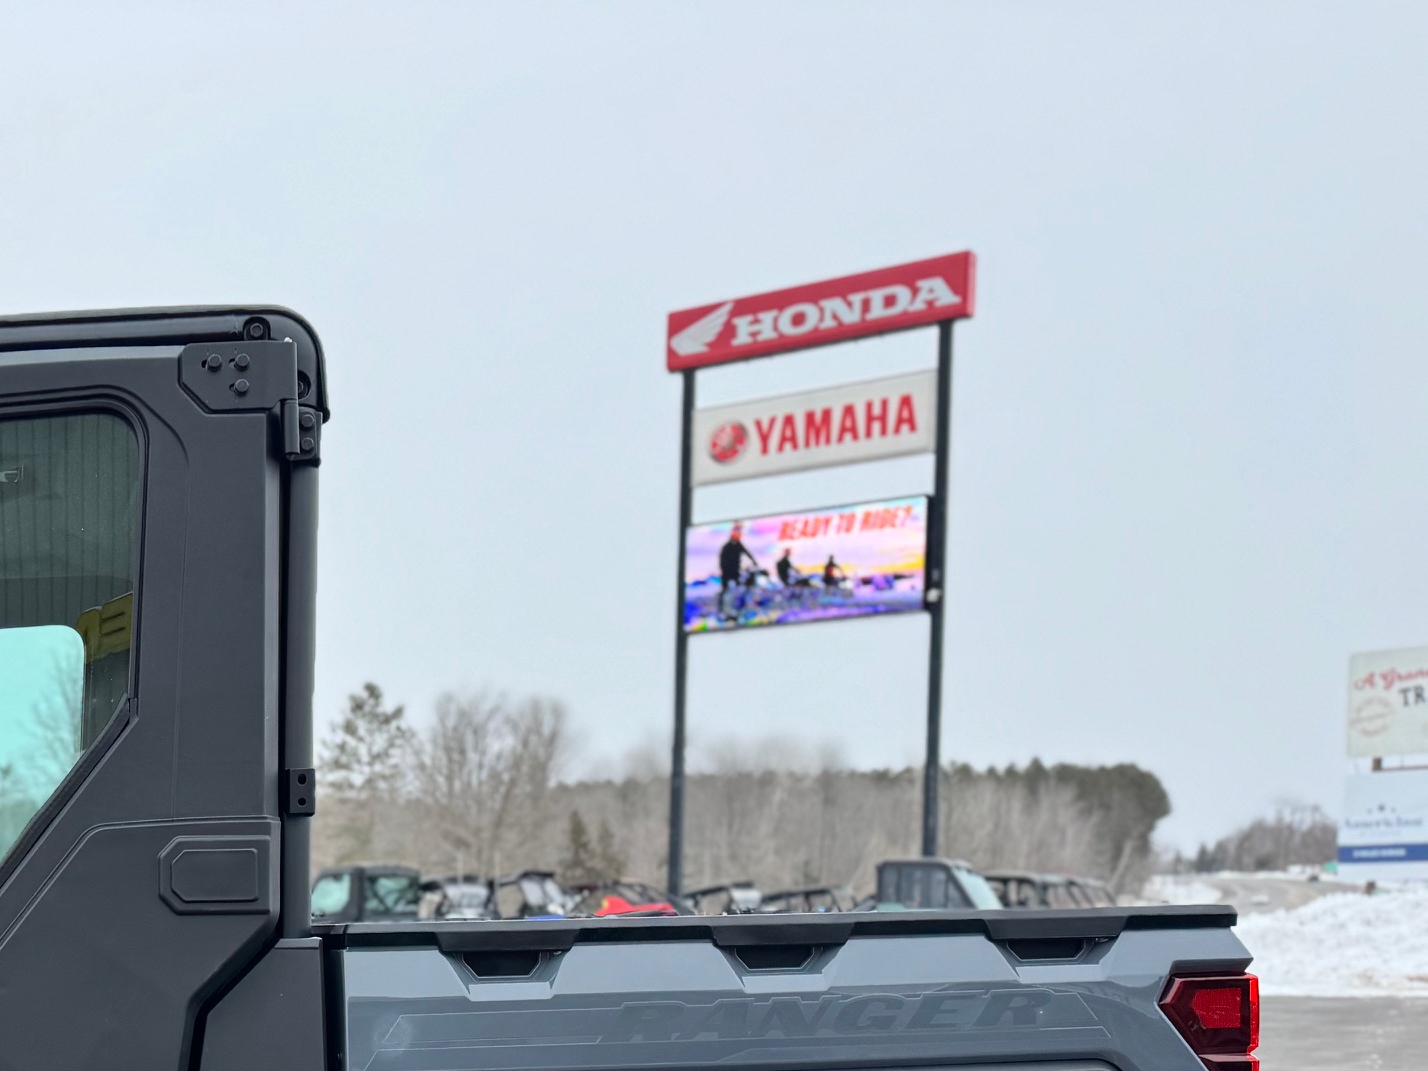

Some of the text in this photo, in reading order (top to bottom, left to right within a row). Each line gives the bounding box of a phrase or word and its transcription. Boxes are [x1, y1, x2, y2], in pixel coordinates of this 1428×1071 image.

[730, 277, 961, 346] HONDA
[754, 394, 918, 456] YAMAHA
[778, 505, 913, 541] READY TO RIDE?
[603, 989, 1053, 1042] RANGER
